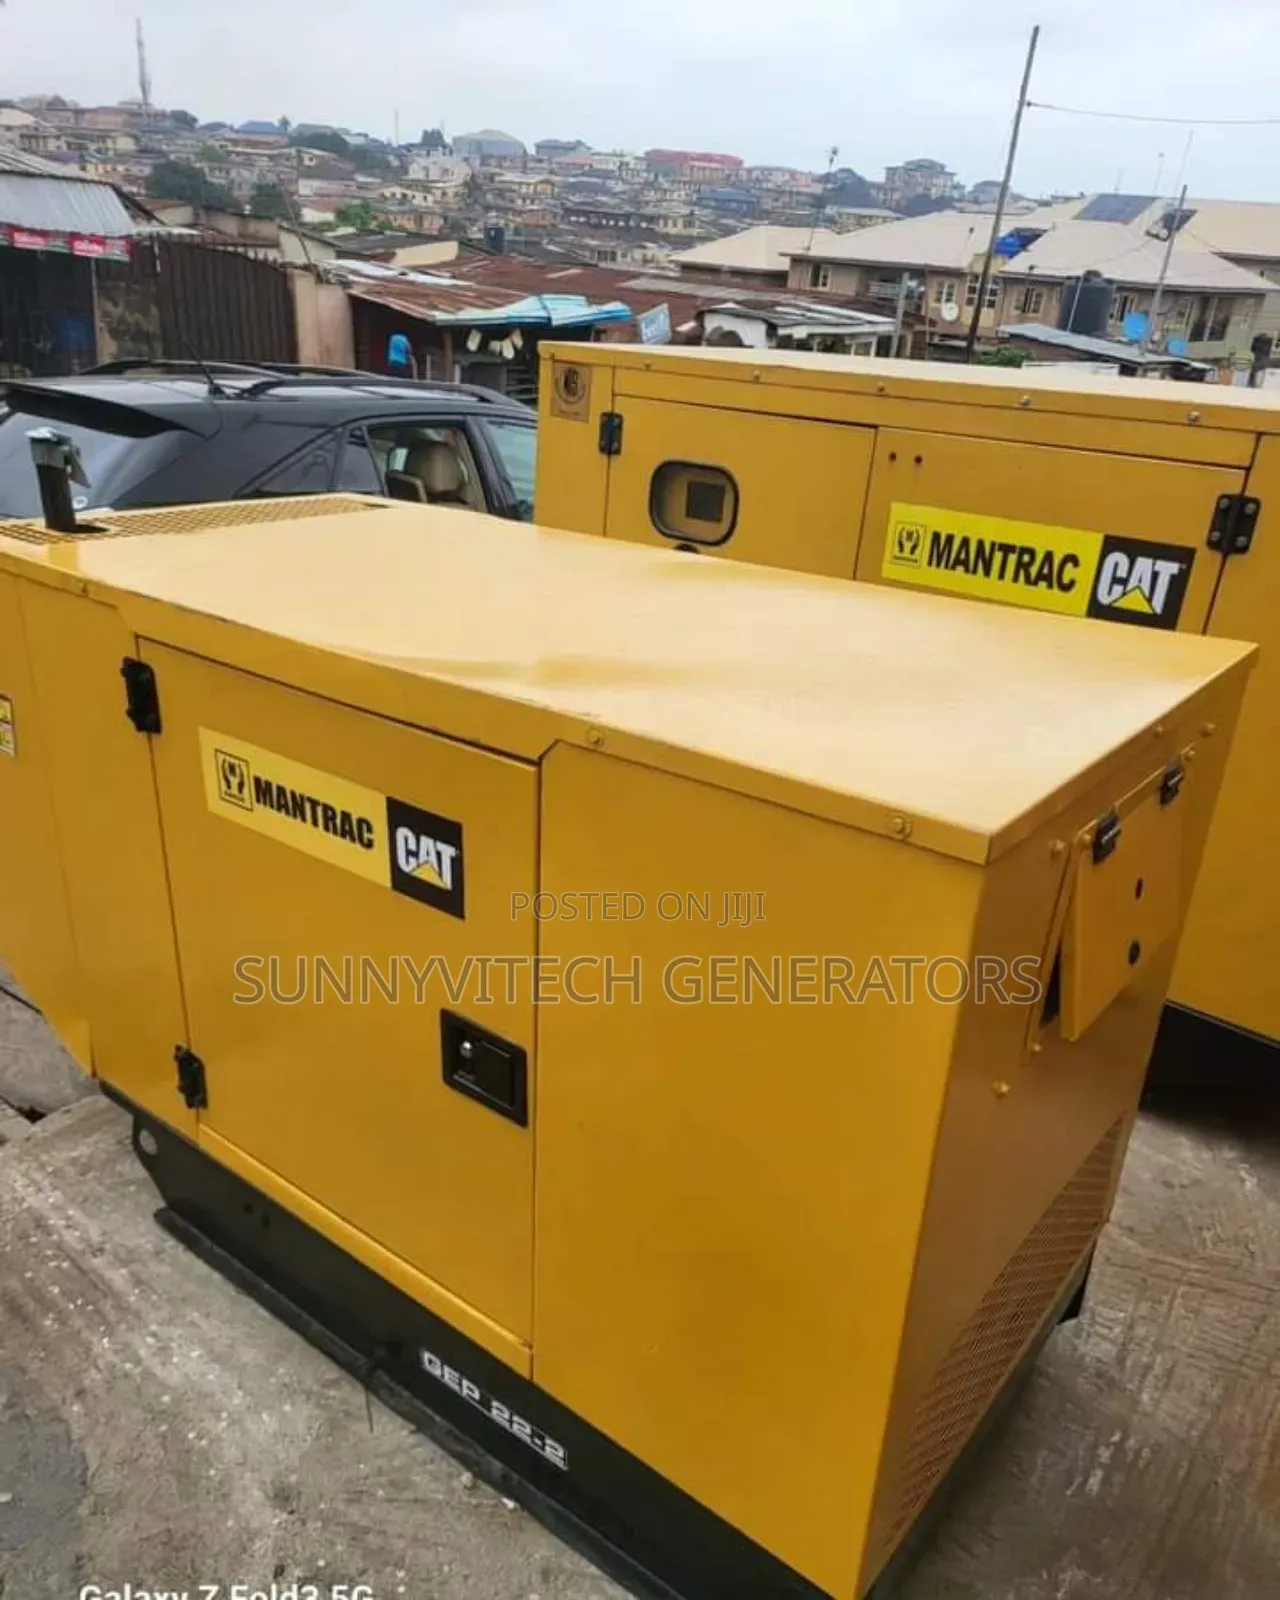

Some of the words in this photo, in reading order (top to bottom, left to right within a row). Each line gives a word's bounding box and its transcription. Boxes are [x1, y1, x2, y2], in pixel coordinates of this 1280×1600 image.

[927, 531, 1080, 593] MANTRAC
[1096, 551, 1180, 615] CAT
[253, 775, 375, 850] MANTRAC
[395, 826, 457, 891] CAT
